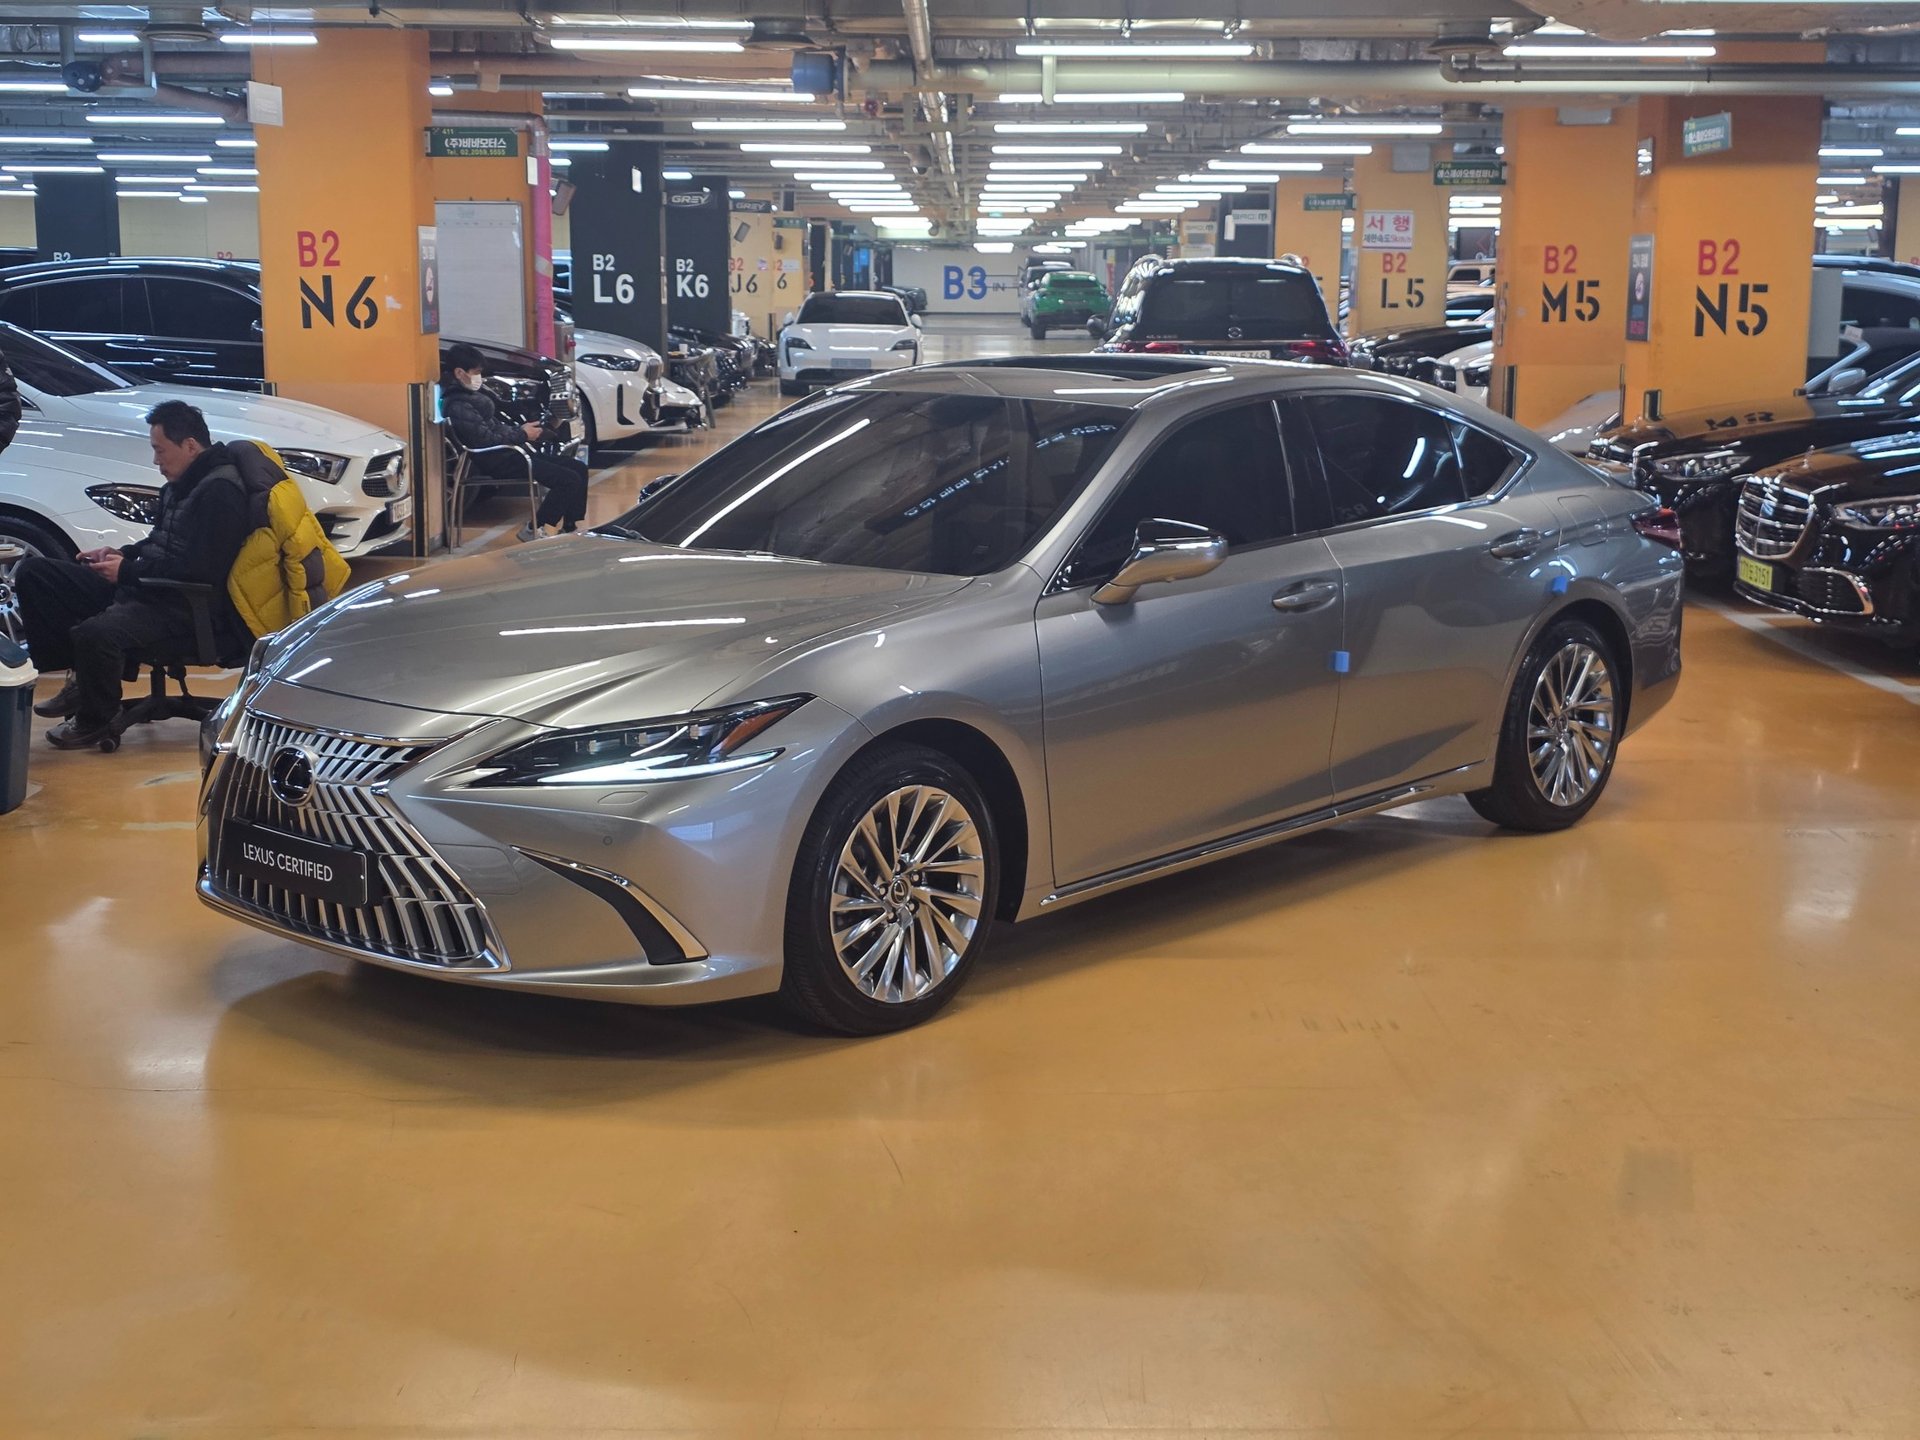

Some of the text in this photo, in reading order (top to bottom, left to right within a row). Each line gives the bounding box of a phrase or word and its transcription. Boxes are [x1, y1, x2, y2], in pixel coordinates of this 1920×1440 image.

[671, 194, 709, 204] GREY
[736, 202, 766, 211] GREY
[297, 230, 340, 267] B2
[593, 254, 615, 271] B2
[1382, 252, 1406, 273] B2
[1544, 244, 1578, 274] B2
[1697, 239, 1741, 276] B2
[676, 259, 694, 272] B2
[593, 274, 635, 304] L6
[676, 274, 709, 298] K6
[731, 274, 758, 293] J6
[944, 266, 986, 299] B3
[1381, 278, 1424, 308] L5
[299, 275, 379, 329] N6
[1541, 280, 1600, 322] M5
[1694, 283, 1769, 336] N5
[243, 842, 333, 882] LEXUS CERTIFIED
